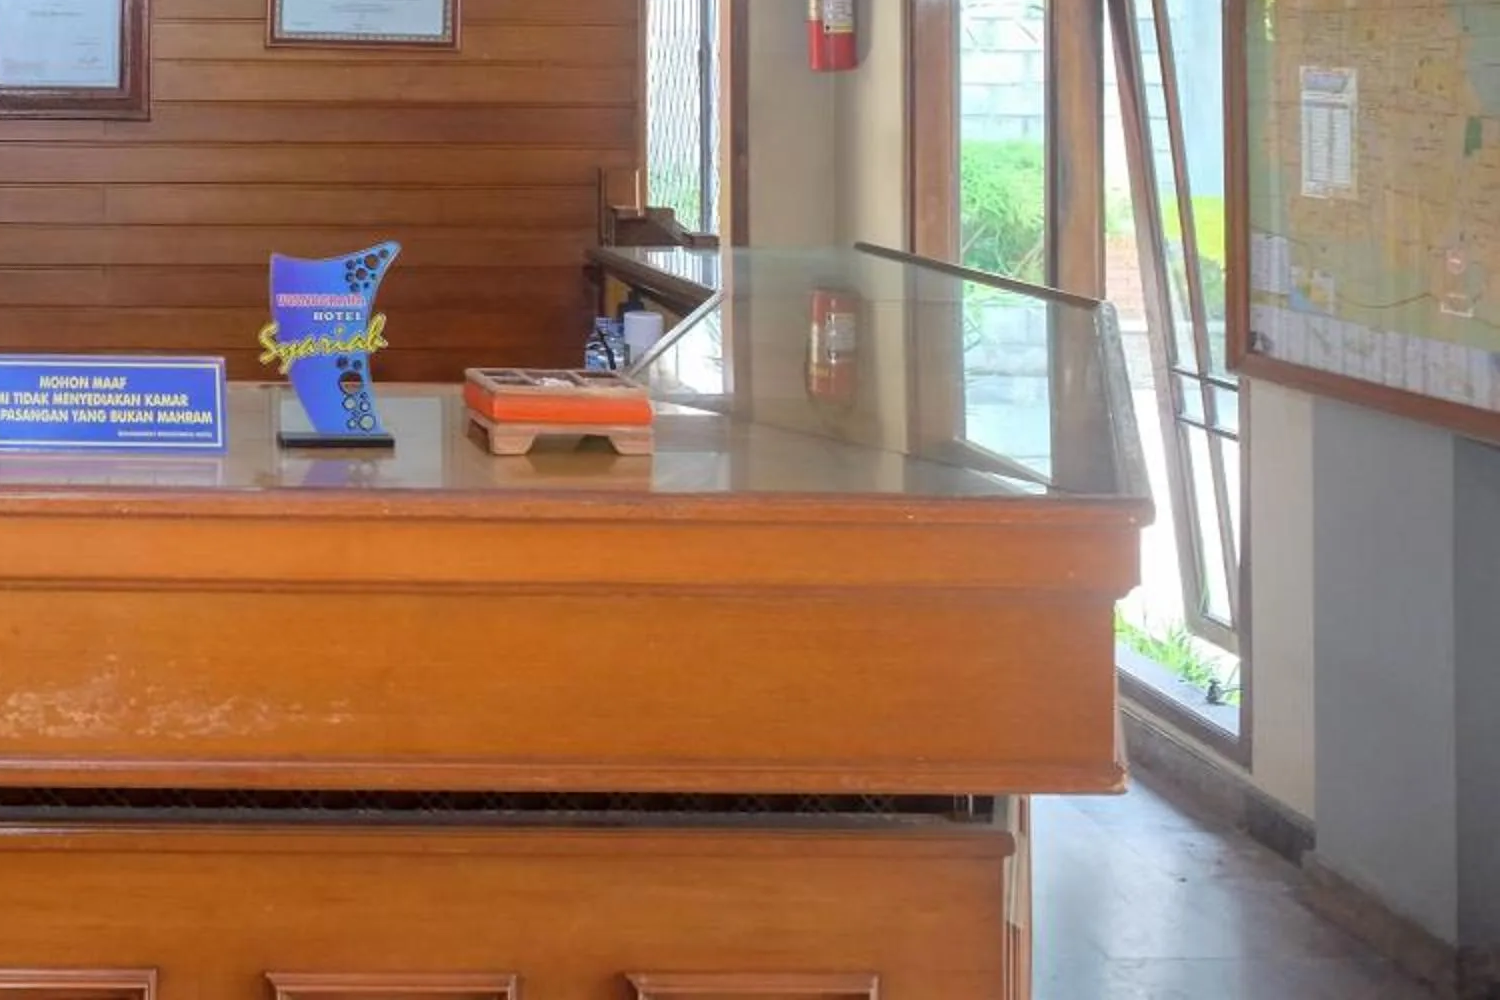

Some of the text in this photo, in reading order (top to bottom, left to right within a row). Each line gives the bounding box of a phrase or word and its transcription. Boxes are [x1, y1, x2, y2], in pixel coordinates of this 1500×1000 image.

[313, 311, 362, 321] HOTEL
[258, 311, 389, 375] Syariah
[40, 375, 127, 389] MOHON MAAF
[12, 391, 49, 406] TIDAK
[52, 391, 141, 406] MENYEDIAKAN
[144, 393, 189, 407] KAMAR
[1, 408, 68, 423] PASANGAN
[72, 409, 107, 423] YANG
[109, 409, 154, 423] BUKAN
[157, 411, 213, 424] MAHRAM
